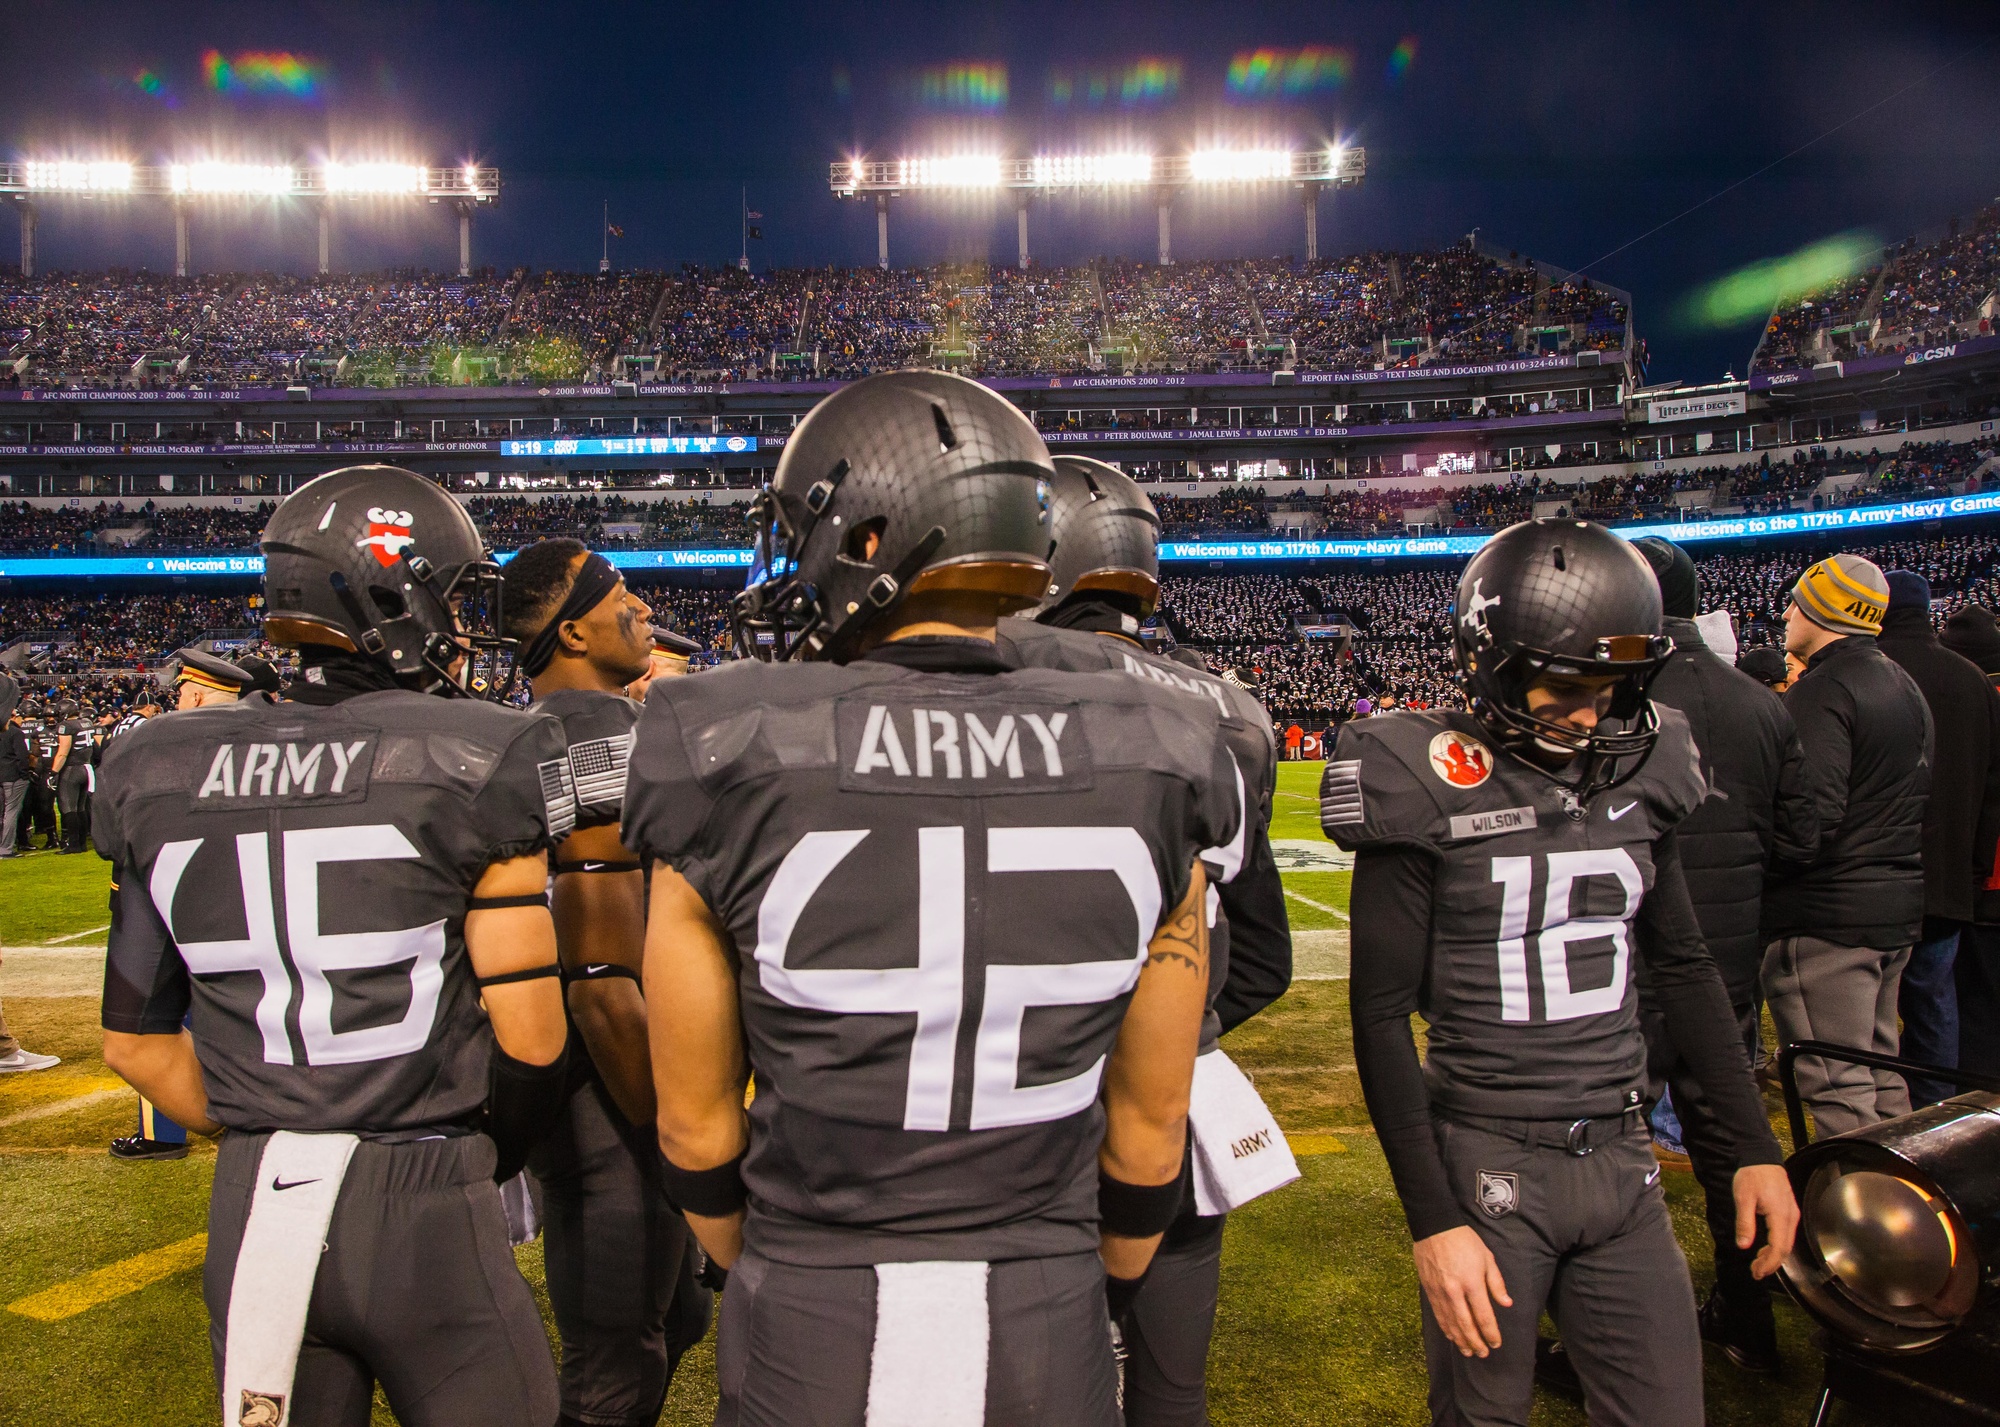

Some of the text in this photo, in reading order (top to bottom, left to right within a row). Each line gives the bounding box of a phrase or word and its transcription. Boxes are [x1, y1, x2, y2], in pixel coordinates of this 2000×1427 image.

[1924, 346, 1956, 362] CSN
[1302, 358, 1569, 382] REPORT FAN ISSUES TEXT ISSUE AND LOCATION TO 410-324-6141
[1072, 379, 1089, 387] AFC
[1091, 378, 1136, 386] CHAMPIONS
[1138, 377, 1158, 385] 2000
[582, 387, 611, 395] WORLD
[640, 386, 686, 394] CHAMPIONS
[1656, 406, 1678, 418] Lite
[1104, 432, 1128, 440] PETER
[1130, 431, 1172, 439] BOULWARE
[1216, 430, 1240, 438] LEWIS
[1257, 429, 1272, 437] RAY
[1274, 429, 1298, 437] LEWIS
[1314, 428, 1325, 436] ED
[1327, 428, 1348, 436] REED
[44, 446, 85, 454] JONATHAN
[511, 442, 541, 454] 9:19
[1671, 497, 2000, 538] Welcome to the 117th Army-Navy Game
[1174, 540, 1447, 556] Welcome to the 117th Army-Navy Game
[163, 558, 263, 571] Welcome to th
[673, 552, 754, 564] Welcome to
[854, 705, 1068, 778] ARMY
[199, 741, 366, 797] ARMY
[1472, 812, 1522, 833] WILSON
[1492, 848, 1644, 1021] 18
[150, 824, 448, 1066] 46
[754, 826, 1162, 1131] 42
[1630, 1091, 1638, 1102] S
[1231, 1129, 1272, 1158] ARMY
